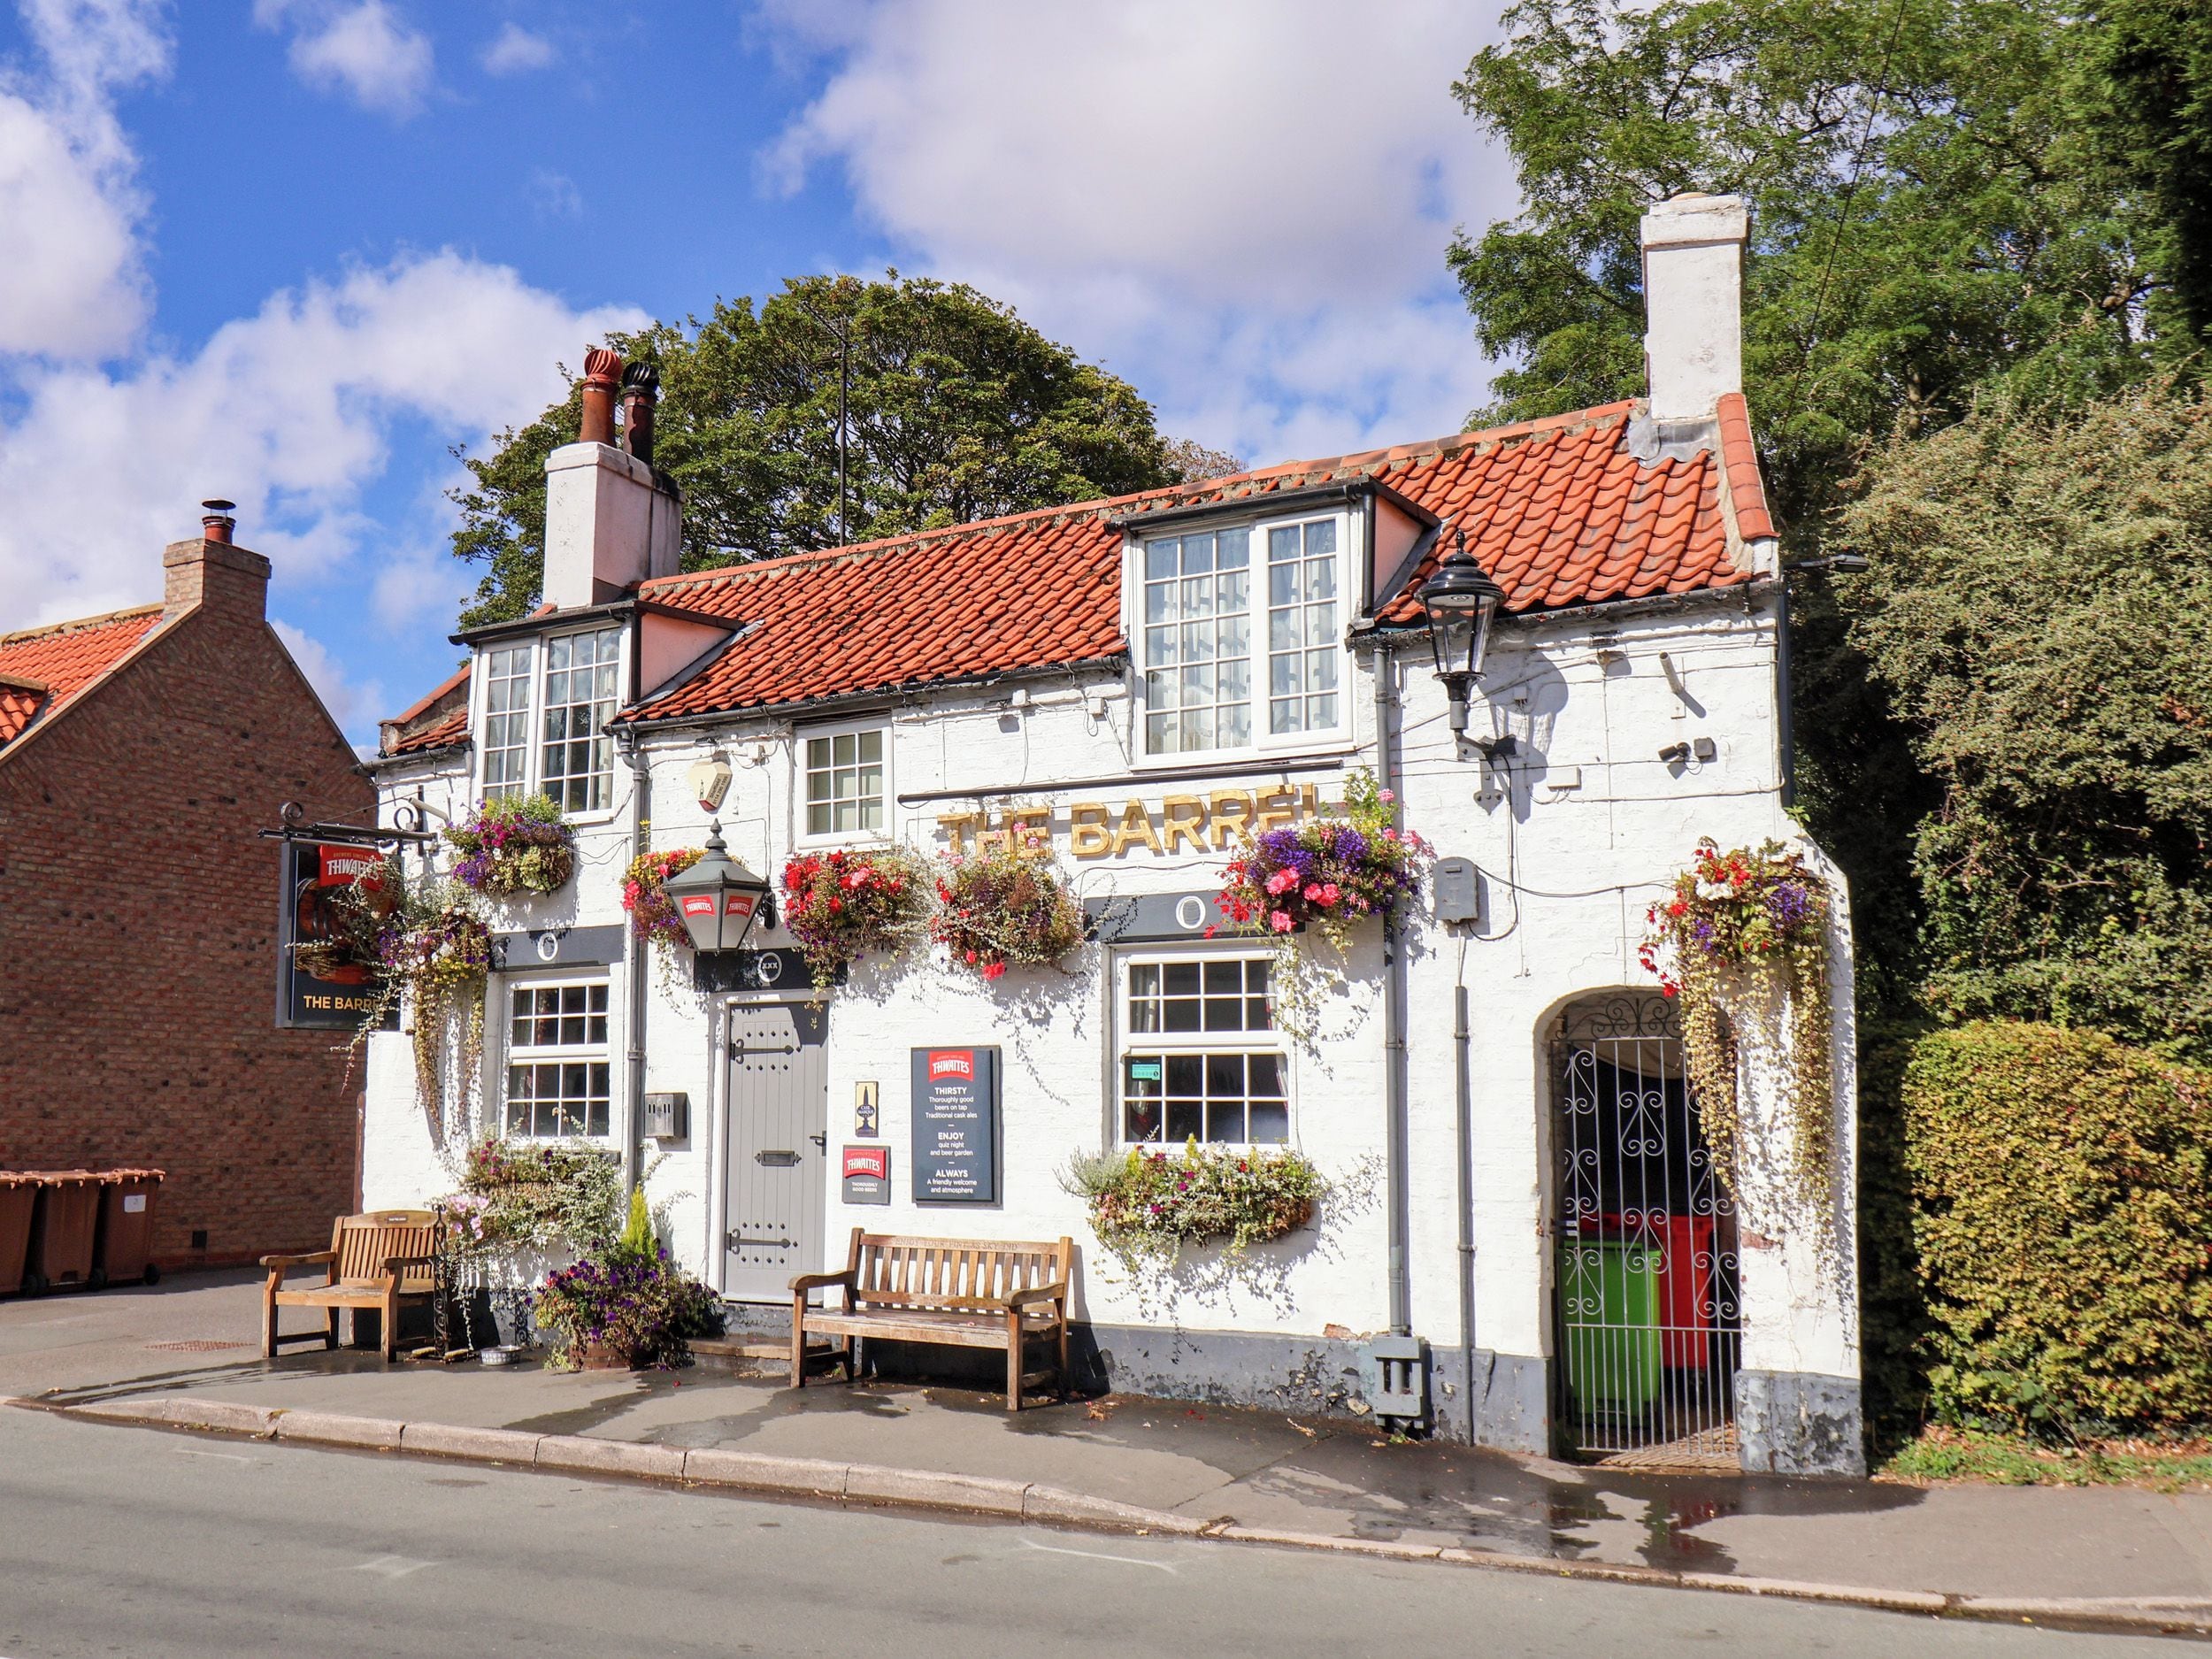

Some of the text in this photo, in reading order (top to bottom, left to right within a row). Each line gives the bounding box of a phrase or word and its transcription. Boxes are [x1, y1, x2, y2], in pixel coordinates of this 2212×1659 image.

[937, 806, 1051, 860] THE
[303, 995, 384, 1010] THE BARRE
[932, 1059, 970, 1074] THWAITES
[934, 1087, 967, 1095] THIRSTY
[938, 1132, 964, 1141] ENJOY
[950, 1141, 964, 1149] night
[847, 1157, 880, 1172] THWAITES
[935, 1169, 969, 1178] ALWAYS
[932, 1178, 952, 1187] friendly
